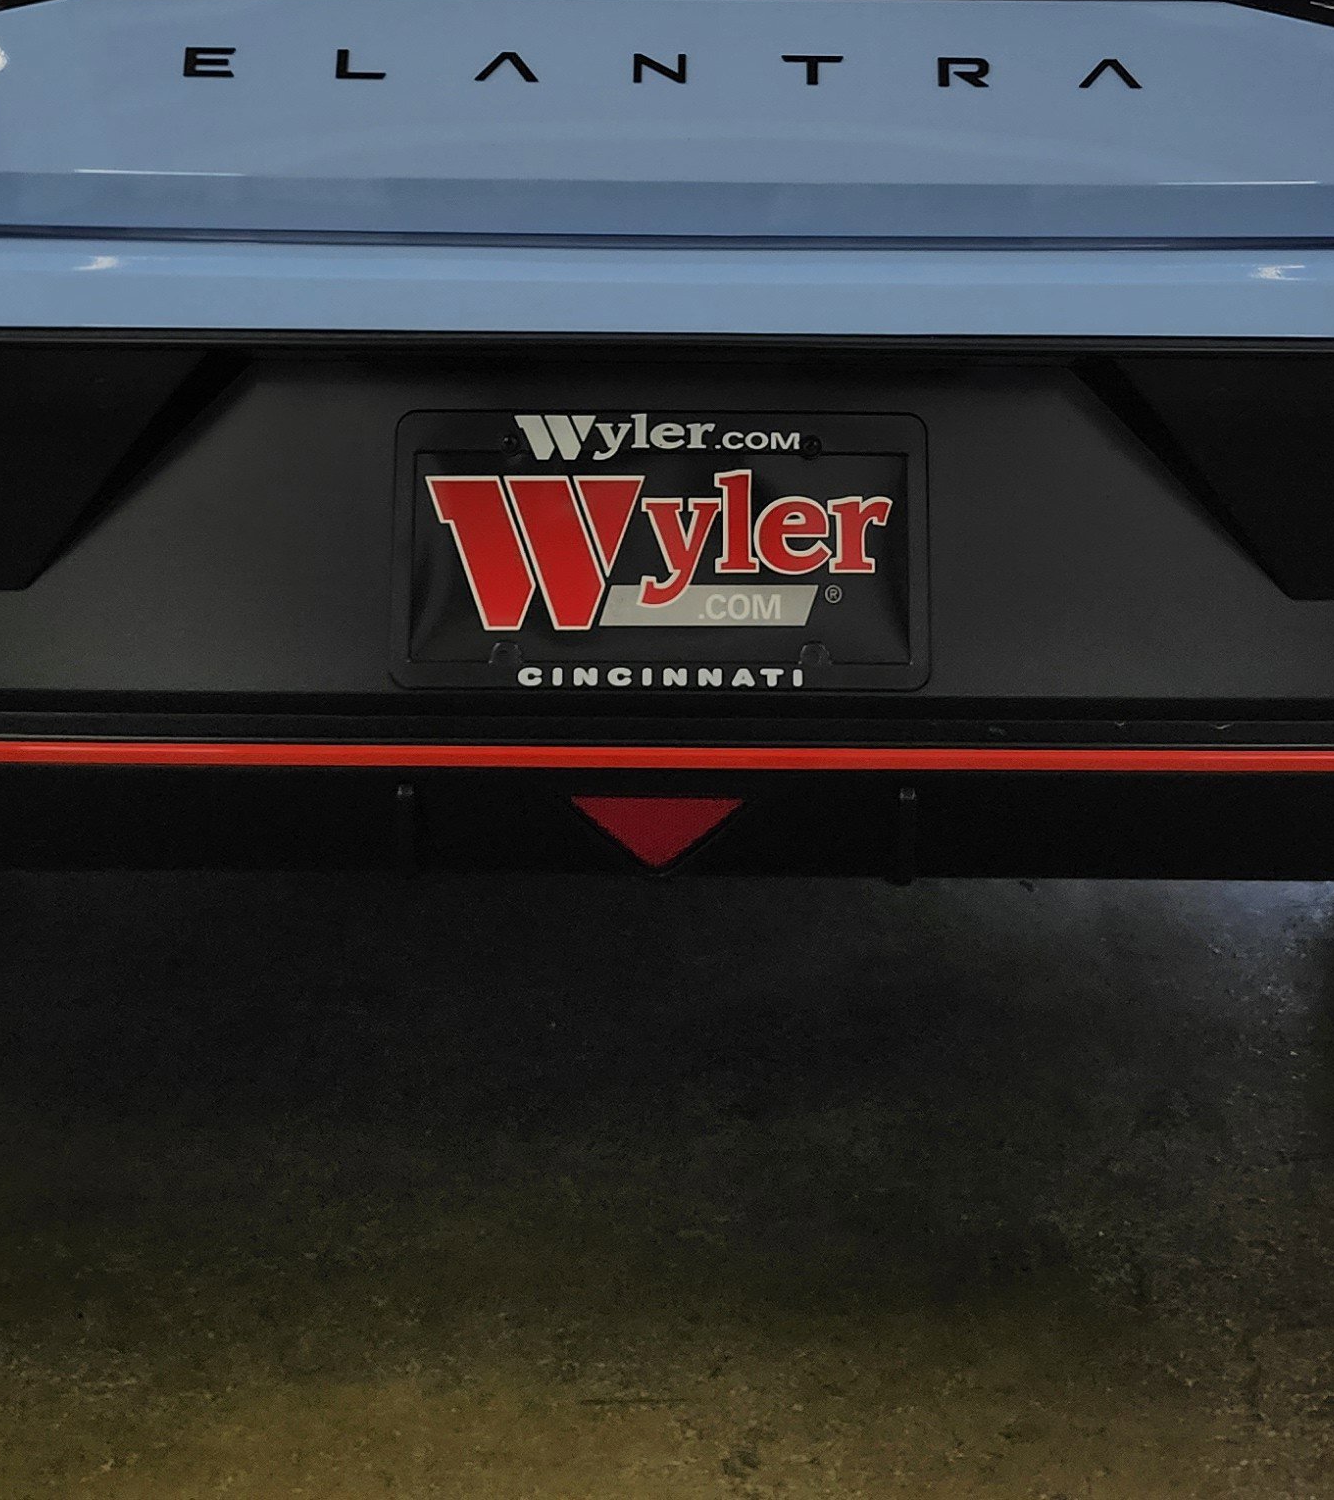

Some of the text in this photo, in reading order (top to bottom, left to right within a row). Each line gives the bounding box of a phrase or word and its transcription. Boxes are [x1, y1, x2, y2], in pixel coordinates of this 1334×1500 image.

[183, 46, 1142, 89] ELANTRA
[425, 469, 893, 631] Wyler
[517, 667, 804, 687] CINCINNATI
